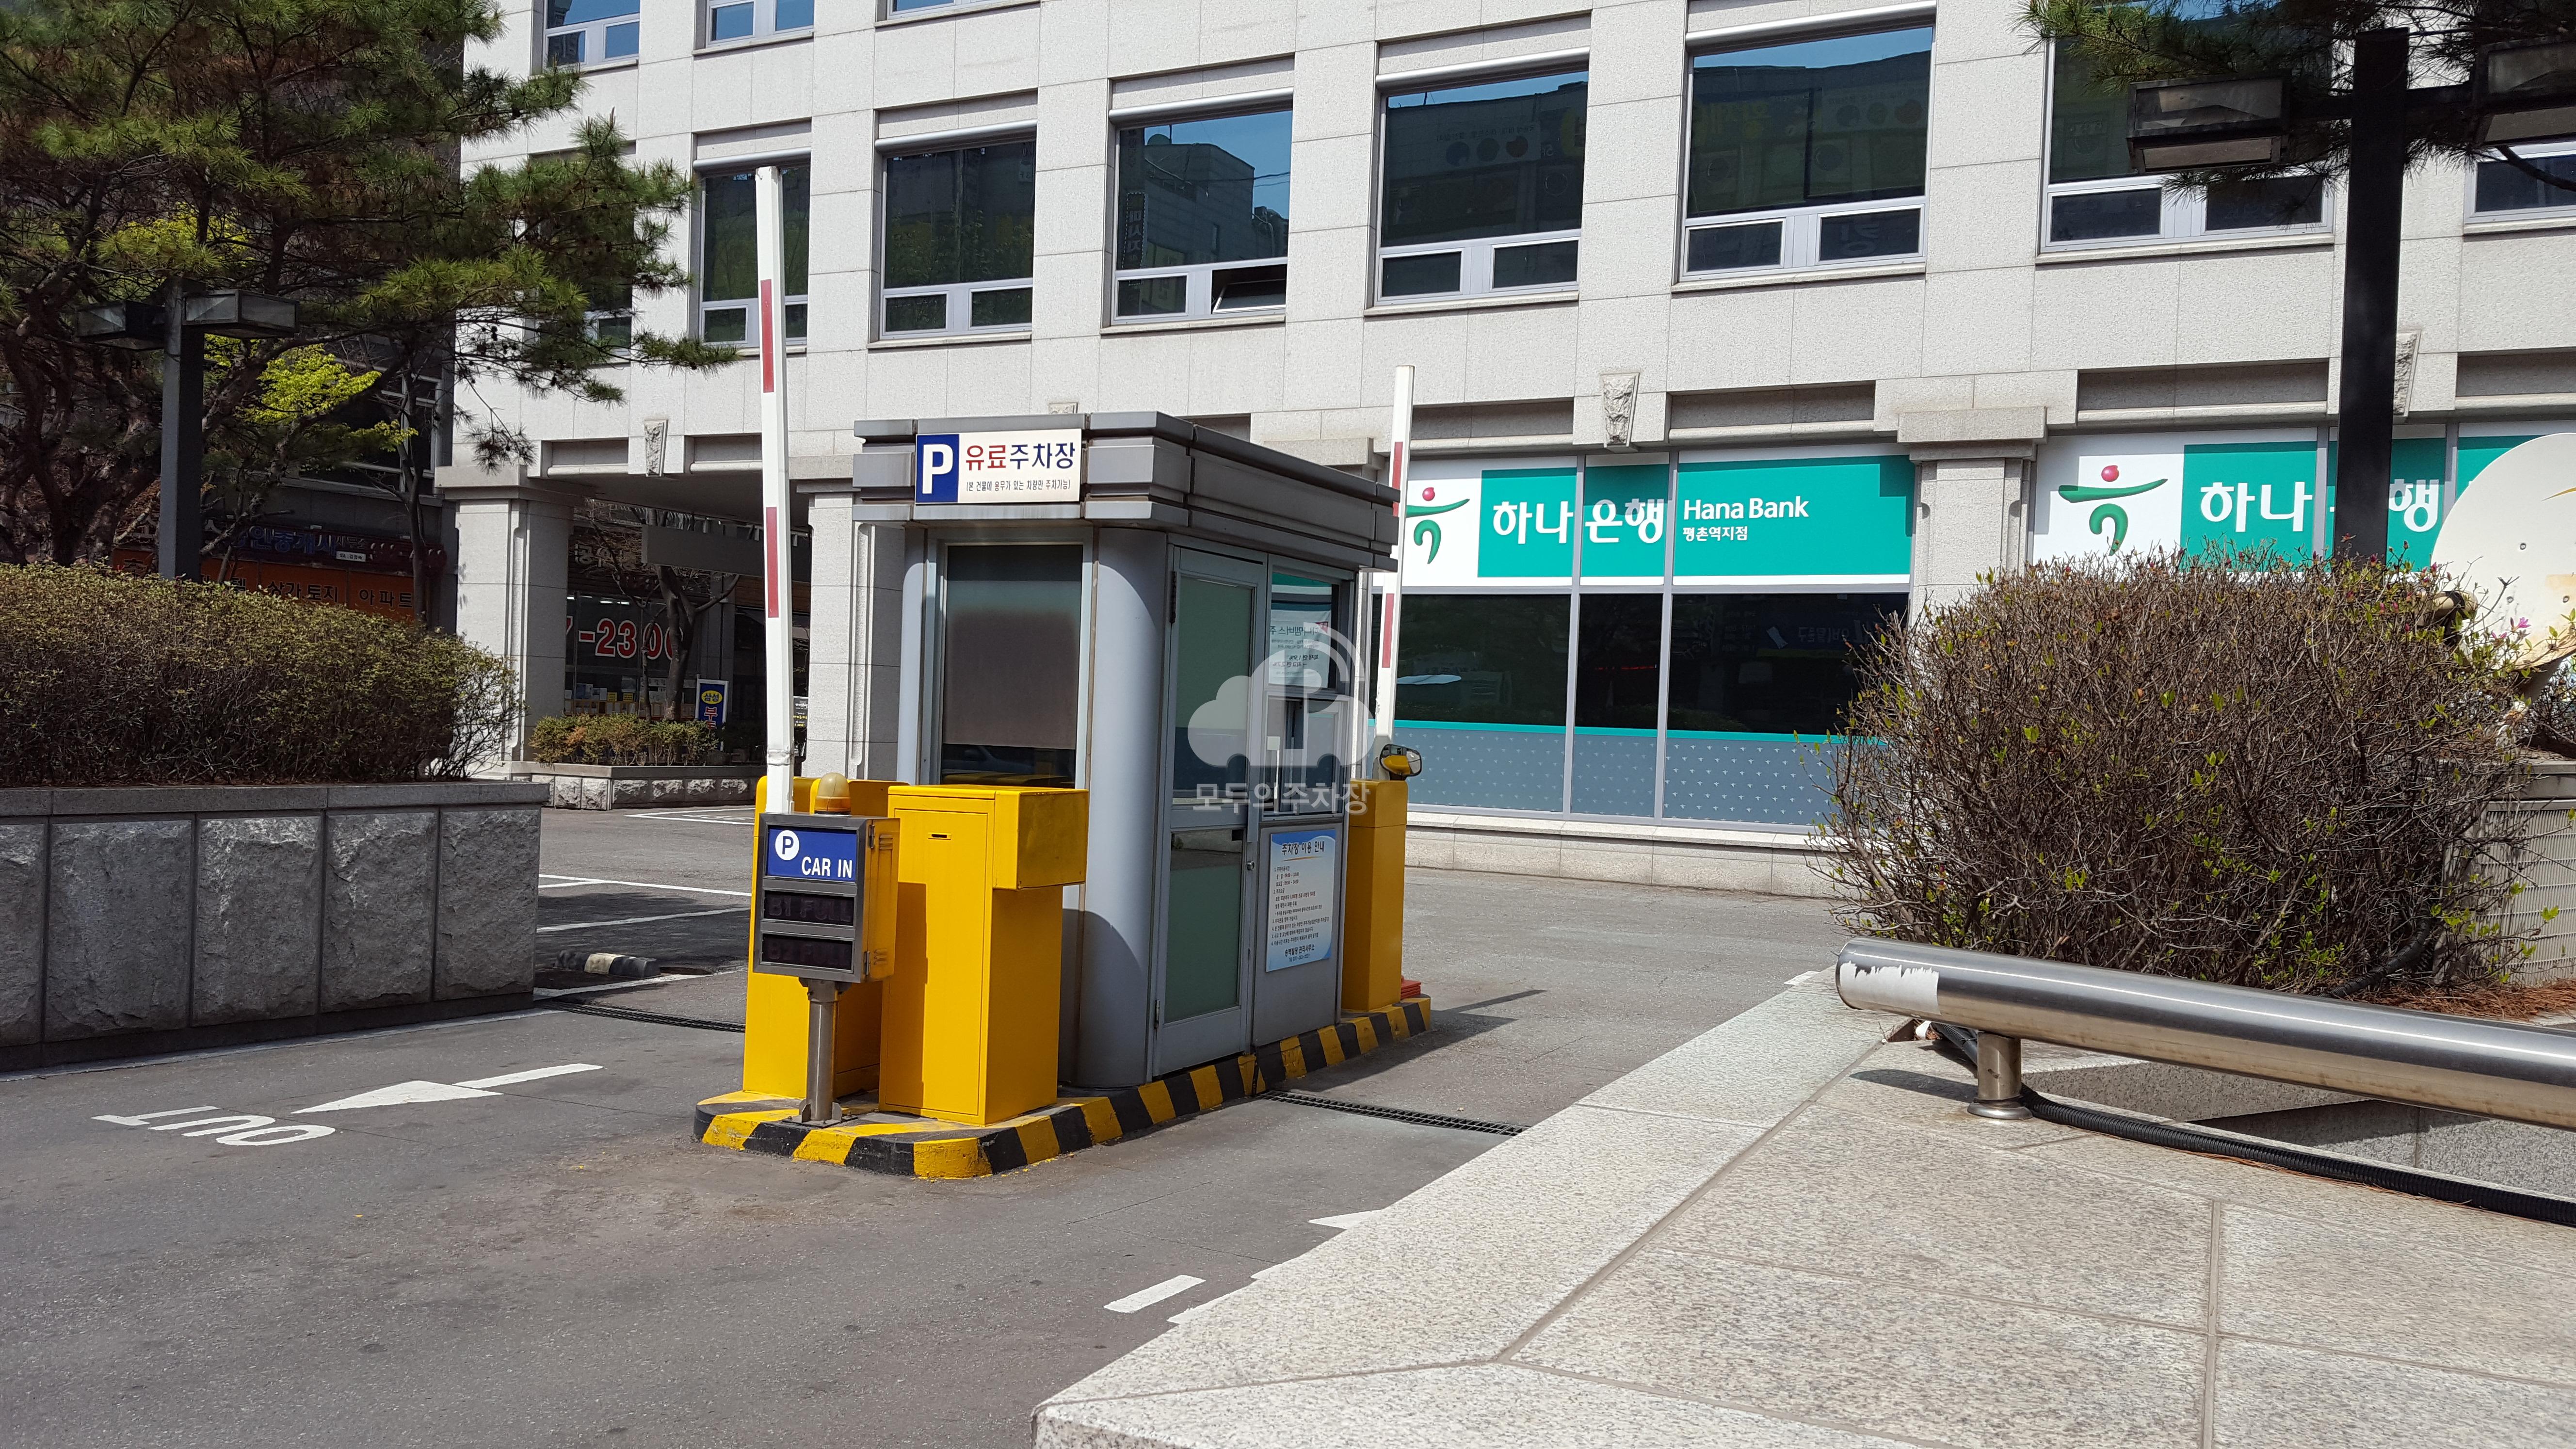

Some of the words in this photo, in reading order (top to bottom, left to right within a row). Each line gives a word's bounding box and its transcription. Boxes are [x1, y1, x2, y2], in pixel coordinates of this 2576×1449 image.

[965, 441, 1076, 471] 유료주차장
[922, 443, 953, 494] P
[966, 482, 974, 491] (본
[976, 481, 992, 491] 건물에
[995, 481, 1011, 492] 용무가
[1013, 480, 1024, 491] 있는
[1026, 480, 1044, 491] 차량만
[1046, 479, 1071, 490] 주차가능)
[1682, 496, 1744, 521] Hana
[1747, 495, 1809, 519] Bank
[2200, 479, 2440, 532] 하나행
[1492, 498, 1665, 545] 하나은행
[1682, 525, 1749, 542] 평촌역지점
[358, 588, 414, 609] 아파트
[704, 692, 720, 702] 삼성
[782, 836, 794, 855] P
[1282, 843, 1299, 855] 주차장
[1302, 841, 1312, 853] 이용
[1315, 841, 1325, 853] 안내
[802, 856, 831, 877] CAR
[837, 859, 853, 878] IN
[91, 1105, 336, 1146] OUT
